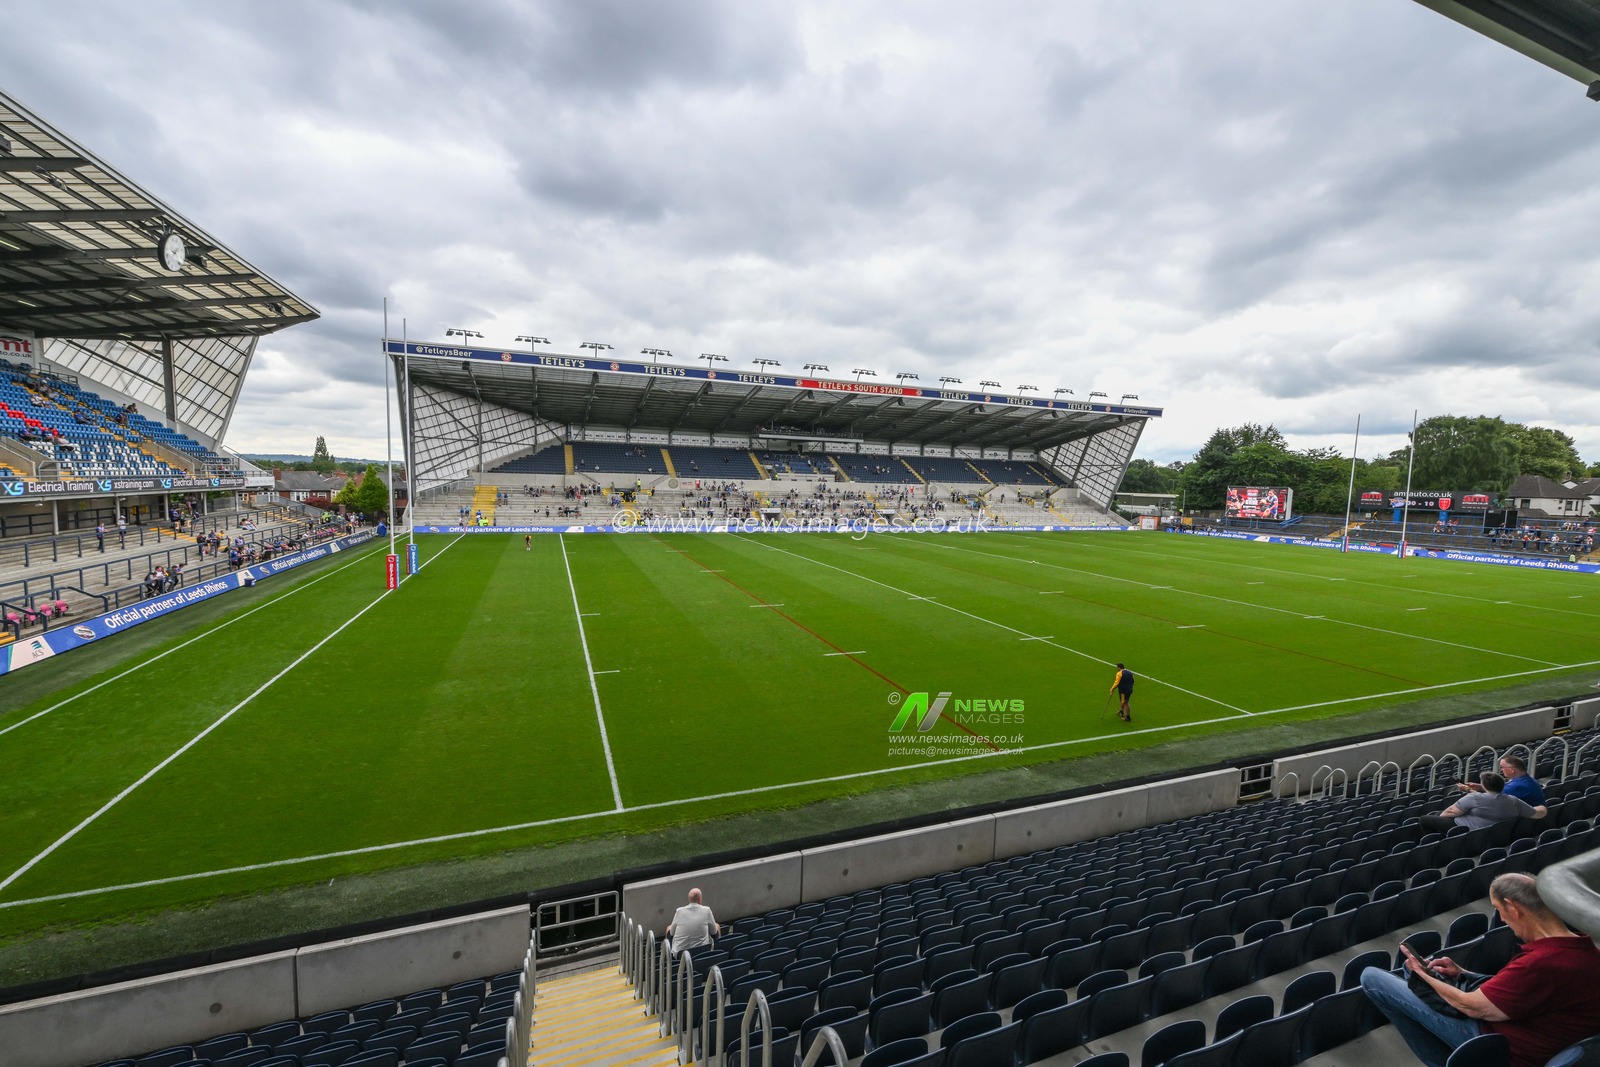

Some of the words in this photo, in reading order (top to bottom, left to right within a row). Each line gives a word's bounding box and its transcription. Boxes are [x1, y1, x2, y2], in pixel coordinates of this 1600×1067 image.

[416, 346, 472, 357] @TetleysBeer
[539, 356, 585, 368] TETLEY'S
[644, 365, 685, 376] TETLEY'S
[738, 374, 775, 384] TETLEY'S
[818, 381, 852, 391] TETLEY'S
[854, 384, 877, 393] SOUTH
[880, 386, 903, 395] STAND
[940, 391, 969, 400] TETLEY'S
[1007, 397, 1033, 406] TETLEY'S
[1068, 403, 1092, 411] TETLEY'S
[2, 482, 24, 496] XS
[28, 481, 65, 493] Electrical
[66, 481, 94, 492] Training
[96, 480, 112, 492] XS
[114, 480, 154, 490] xstraining.com
[160, 479, 172, 488] XS
[193, 478, 209, 487] Training
[1475, 556, 1508, 564] partners
[1547, 562, 1579, 570] Rhinos
[104, 610, 141, 629] Official
[142, 598, 176, 618] partners
[175, 594, 184, 604] of
[184, 588, 205, 602] Leeds
[205, 580, 228, 593] Rhinos
[32, 650, 44, 658] ACS
